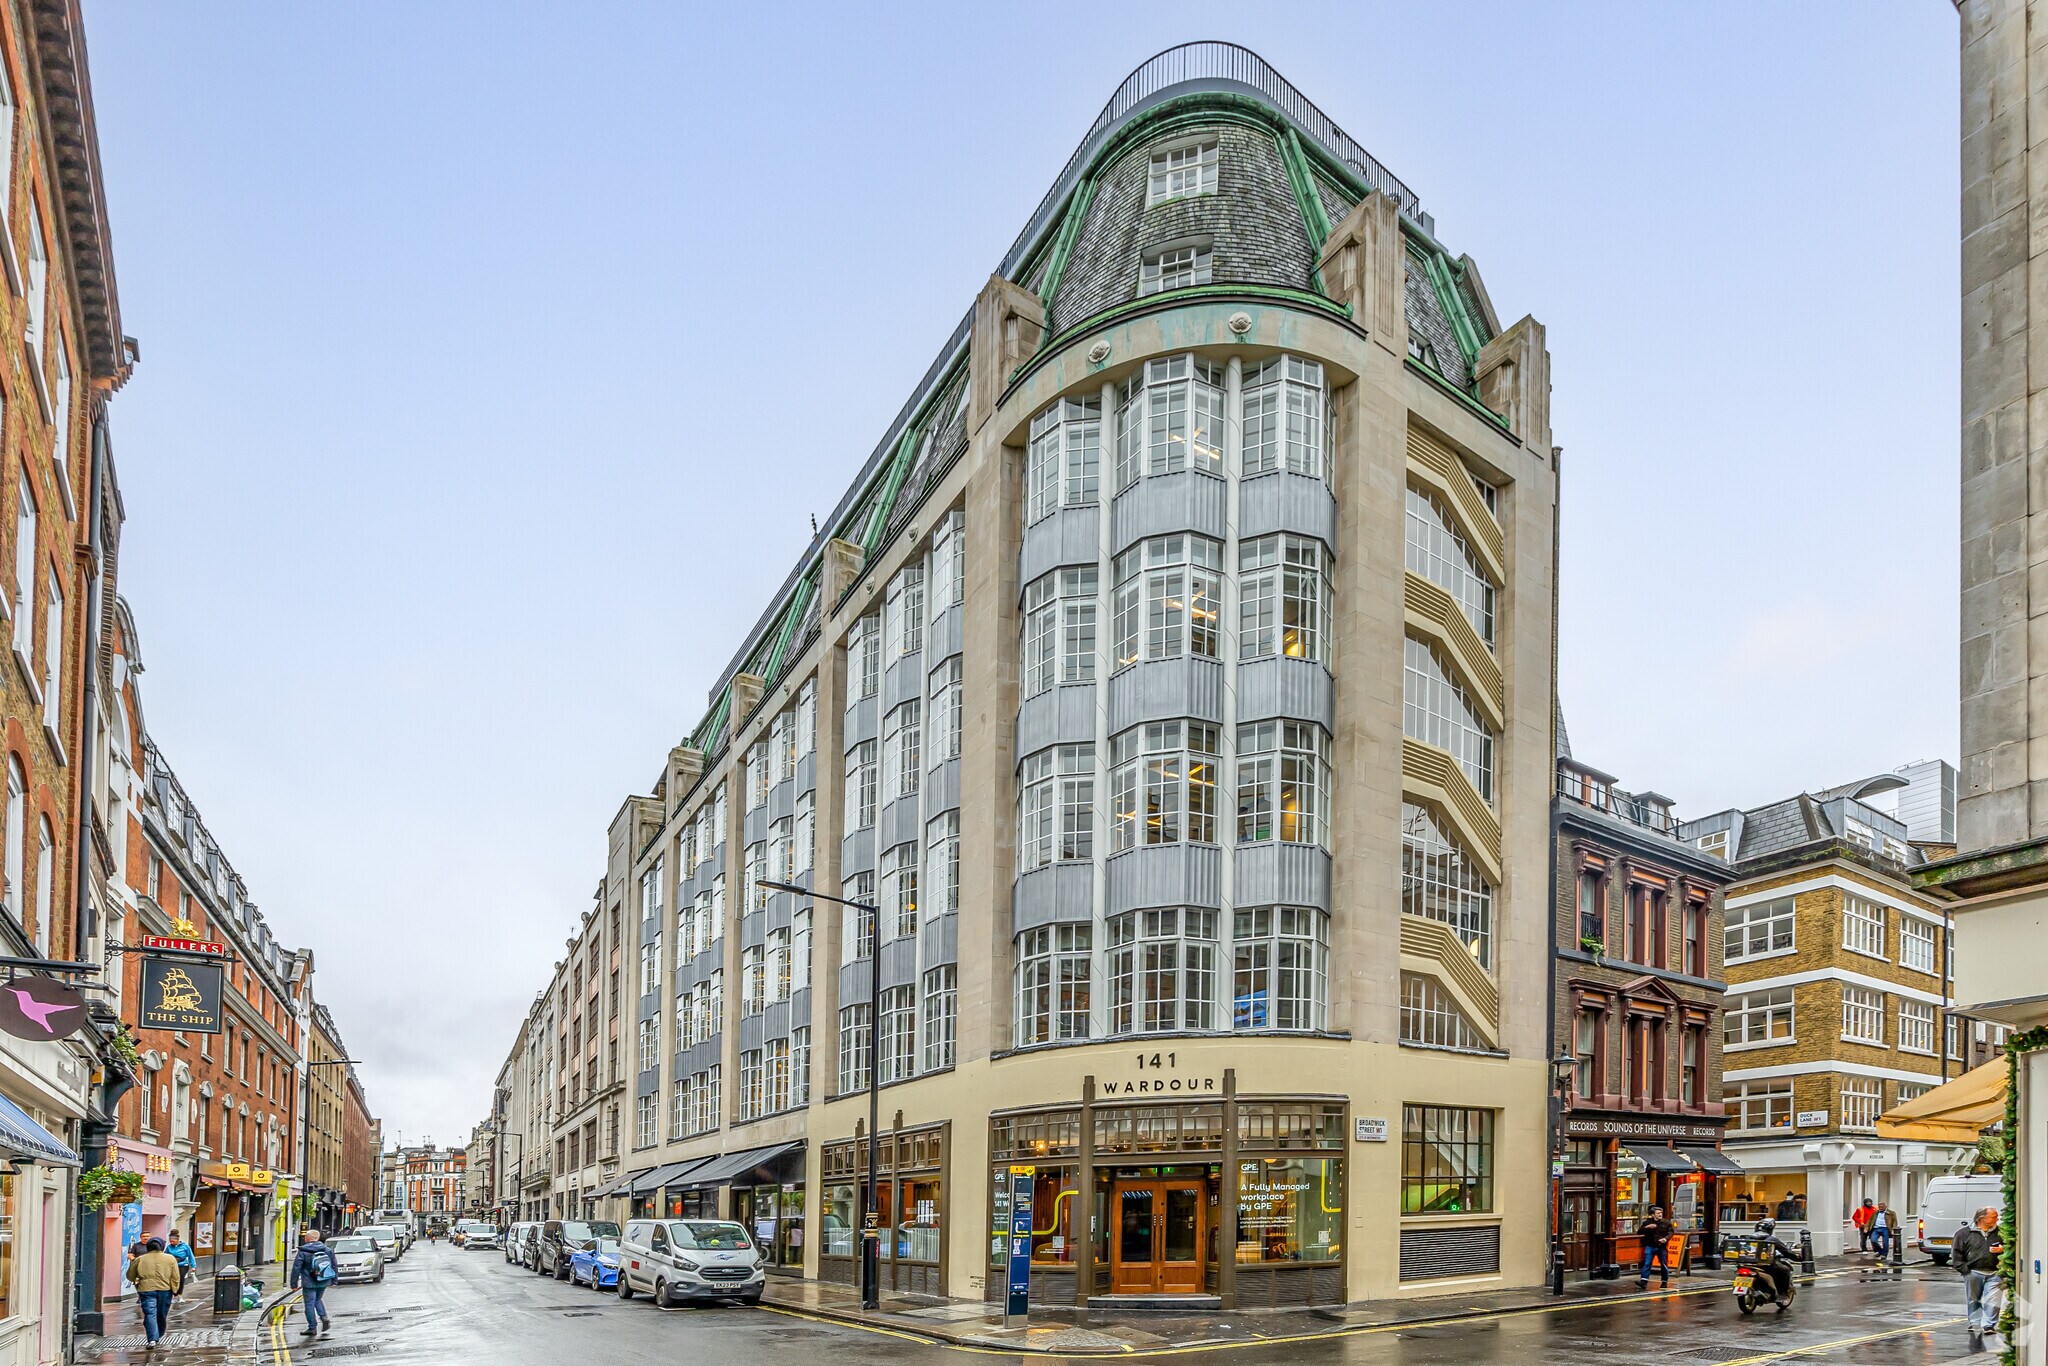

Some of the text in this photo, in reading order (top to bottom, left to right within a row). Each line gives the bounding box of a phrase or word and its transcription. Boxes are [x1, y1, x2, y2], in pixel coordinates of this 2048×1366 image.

[148, 937, 219, 953] FULLER'S
[147, 1012, 213, 1024] THE SHIP
[1136, 1052, 1176, 1069] 141
[1104, 1078, 1214, 1094] WARDOUR
[1569, 1121, 1598, 1131] RECORDS
[1603, 1122, 1686, 1135] SOUNDS OF THE UNIVERSE
[1693, 1127, 1716, 1136] RECORDS
[1249, 1183, 1271, 1192] Fully
[1272, 1182, 1310, 1191] Managed
[1240, 1193, 1285, 1202] workplace
[1254, 1202, 1272, 1210] GPE
